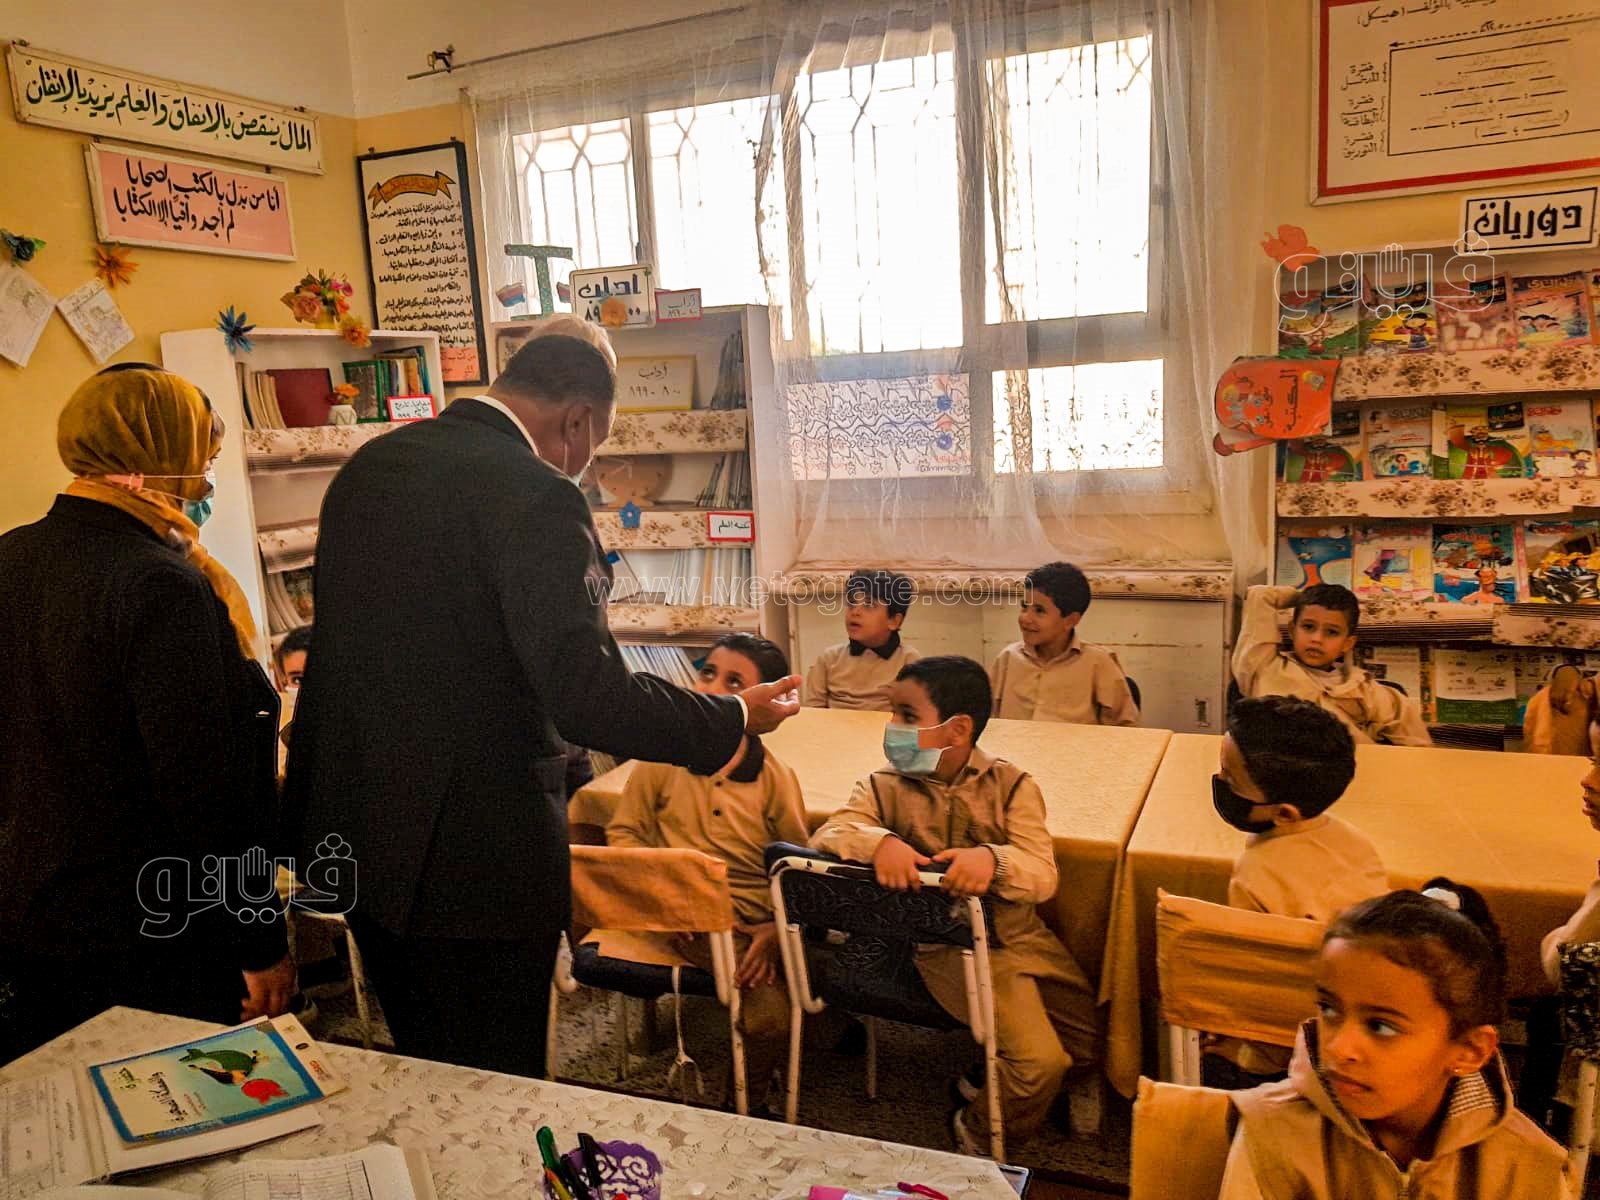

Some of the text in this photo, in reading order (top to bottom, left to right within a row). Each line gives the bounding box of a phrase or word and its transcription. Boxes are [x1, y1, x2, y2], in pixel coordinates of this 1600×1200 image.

[279, 121, 311, 152] المال
[249, 191, 266, 210] من
[226, 208, 236, 243] لم
